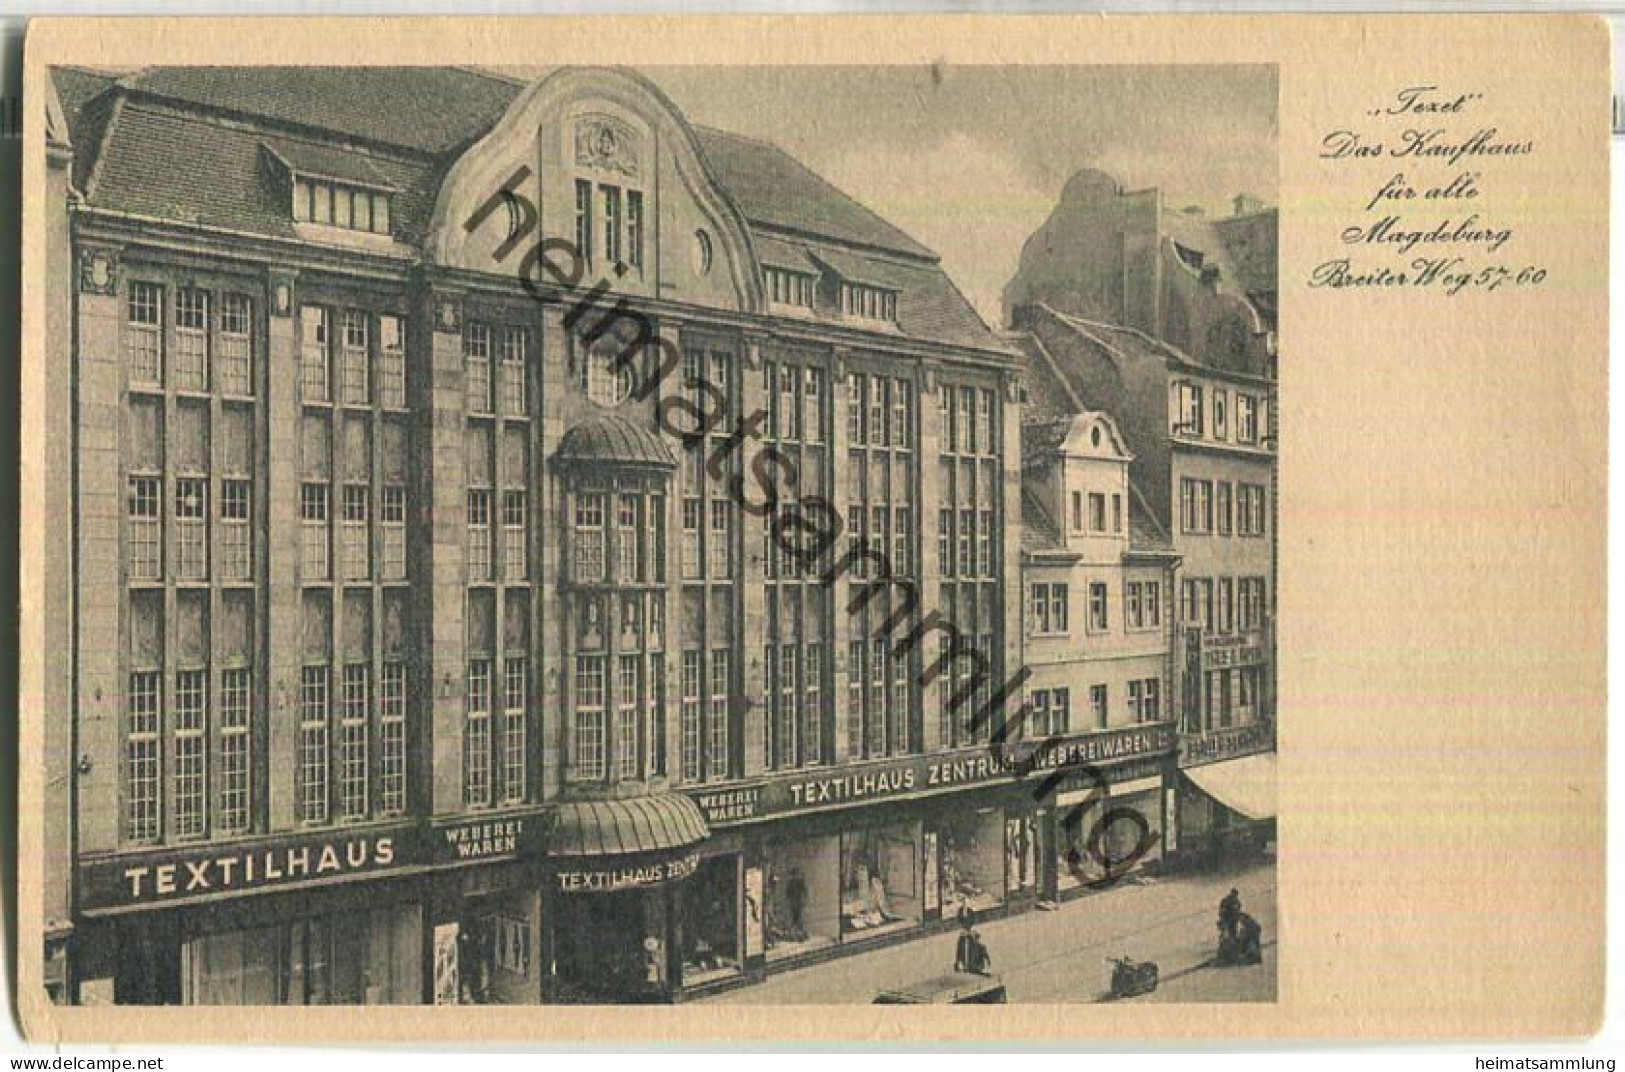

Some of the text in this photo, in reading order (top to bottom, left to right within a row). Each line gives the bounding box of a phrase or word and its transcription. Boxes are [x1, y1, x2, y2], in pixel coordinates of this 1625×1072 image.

[1319, 127, 1534, 165] Das Kaufhaus
[1366, 171, 1482, 211] für alle
[1341, 214, 1514, 254] Magdeburg
[1307, 257, 1547, 296] Breiter Weg 57-60
[790, 770, 915, 806] TEXTILHAUS
[446, 819, 523, 844] WEBEREI
[458, 835, 516, 858] WAREN
[125, 837, 395, 897] TEXTILHAUS
[556, 864, 663, 891] TEXTILHAUS
